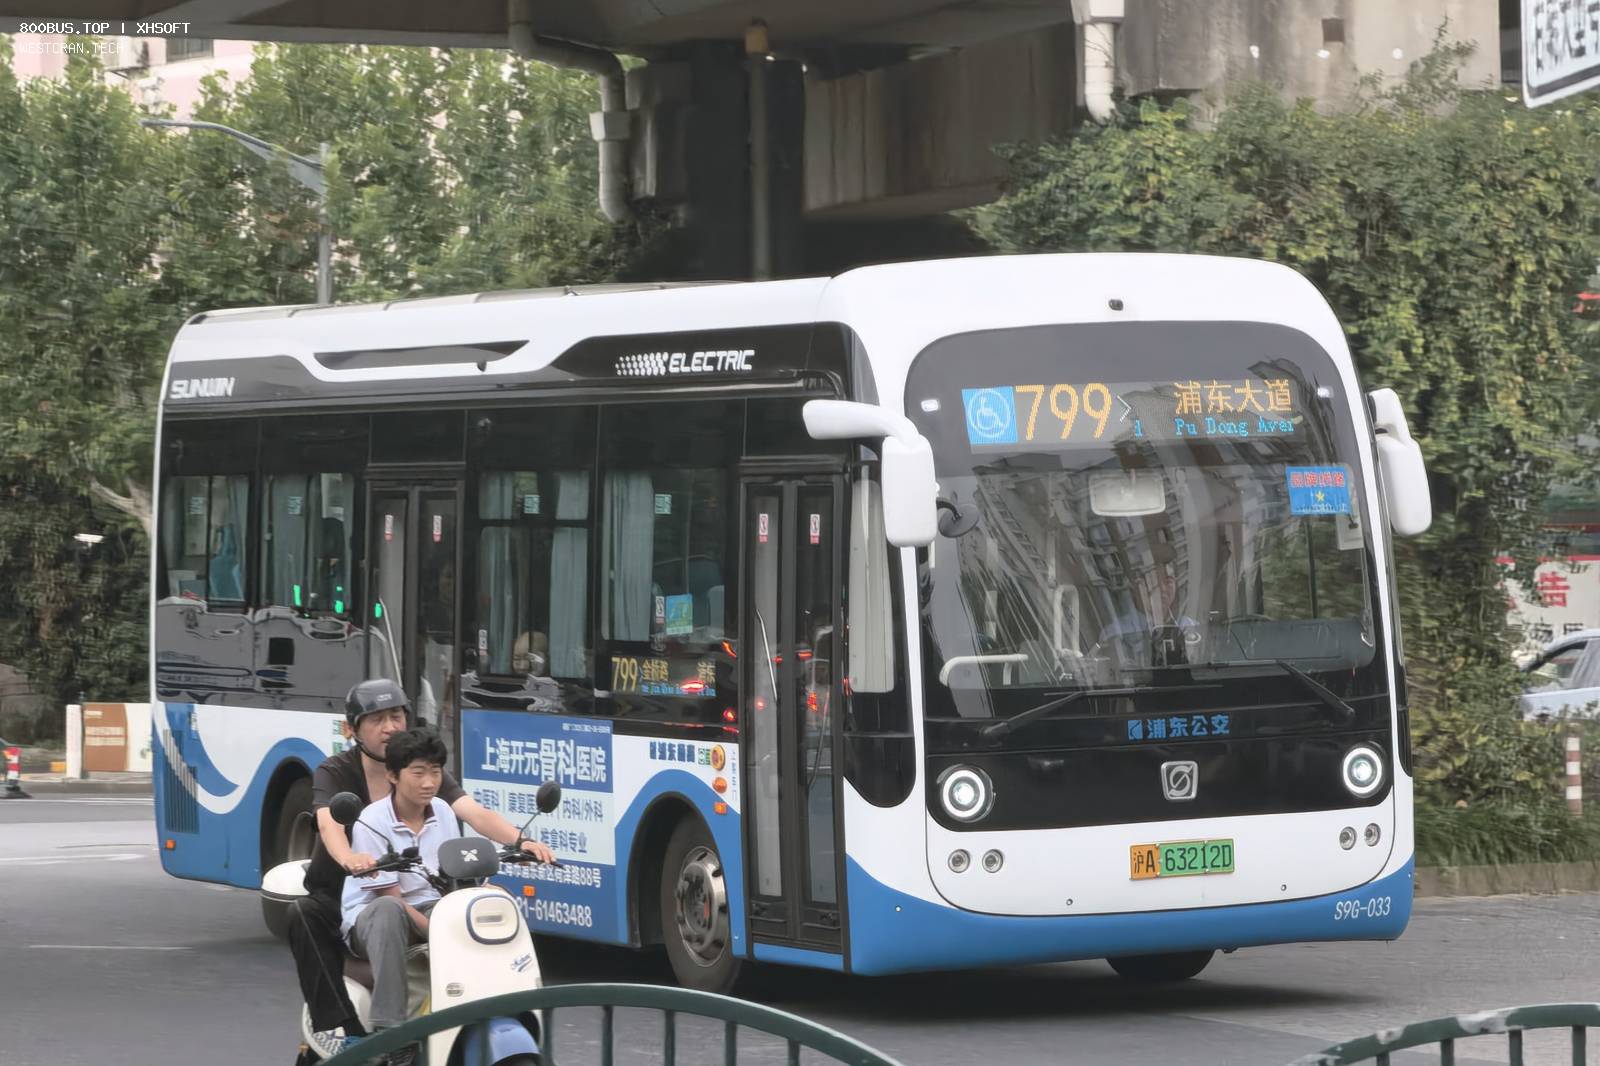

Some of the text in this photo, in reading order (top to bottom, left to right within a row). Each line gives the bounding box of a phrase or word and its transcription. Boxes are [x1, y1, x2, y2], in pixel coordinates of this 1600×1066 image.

[669, 350, 755, 373] ELECTRIC
[170, 377, 235, 399] SUNWIN
[1173, 379, 1292, 415] 浦东大道
[1015, 382, 1112, 441] 799
[1175, 418, 1198, 436] Pu
[1205, 416, 1249, 437] Dong
[611, 656, 638, 692] 799
[1147, 714, 1230, 739] 浦东公交
[481, 736, 607, 785] 上海开元骨科医院
[508, 791, 558, 817] 康复医
[1133, 844, 1232, 874] 沪A 63212D
[1334, 896, 1391, 920] S9G-033
